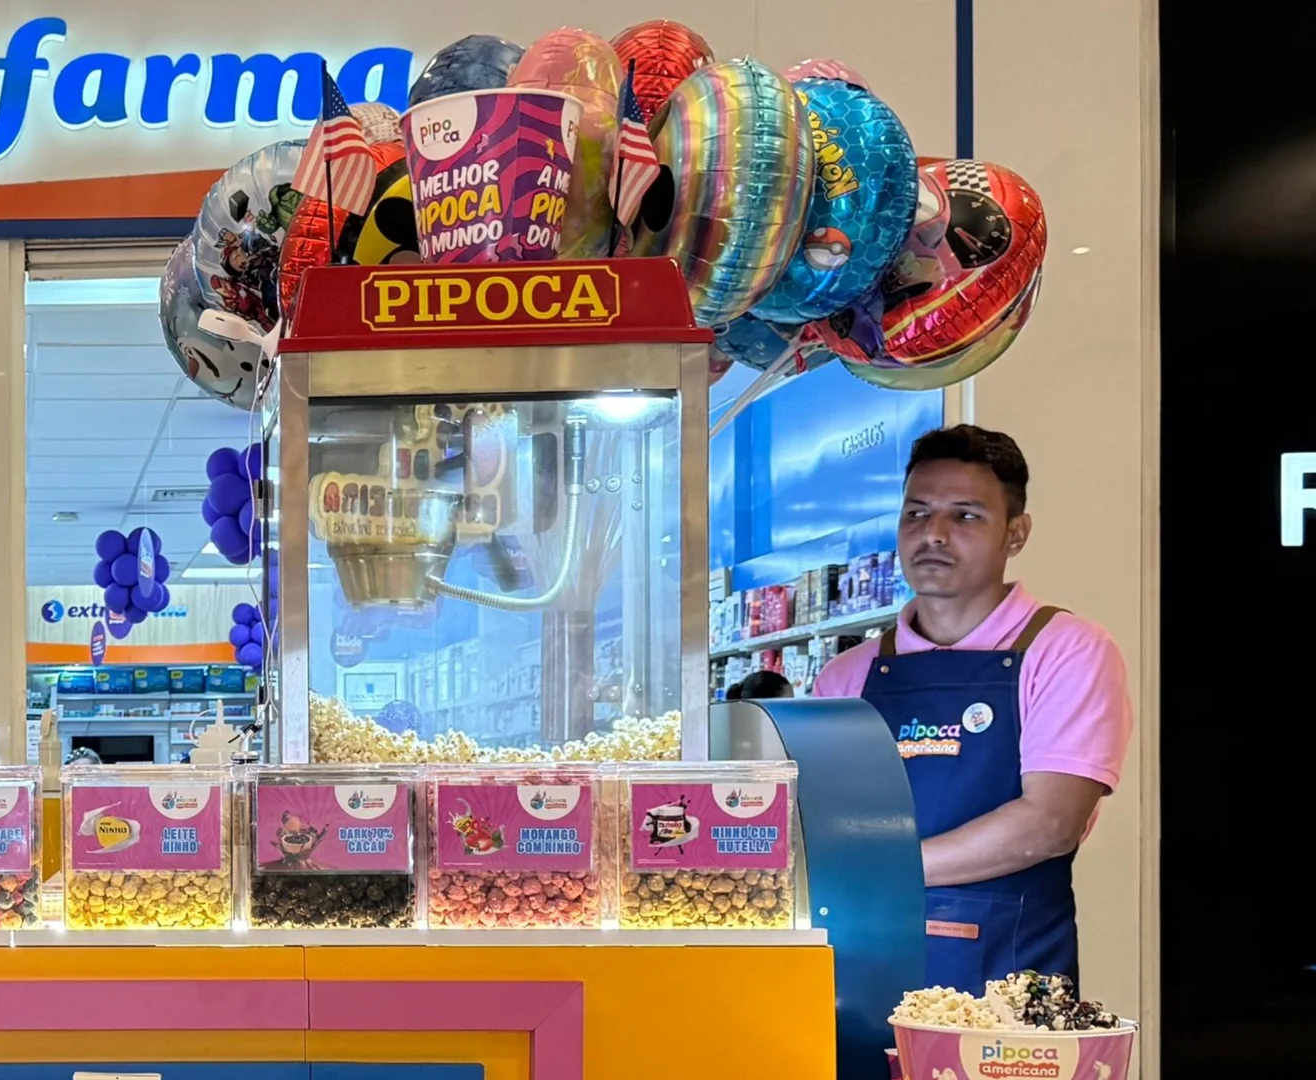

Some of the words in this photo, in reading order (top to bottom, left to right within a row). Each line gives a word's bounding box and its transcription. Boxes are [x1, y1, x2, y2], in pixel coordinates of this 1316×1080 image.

[420, 117, 452, 145] pipo
[443, 130, 460, 144] ca
[420, 159, 500, 201] MELHOR
[537, 165, 552, 188] A
[431, 220, 504, 256] MUNDO
[526, 224, 550, 249] DO
[372, 273, 609, 323] PIPOCA
[897, 718, 961, 741] pipoca
[99, 825, 128, 834] NINHO
[163, 827, 197, 840] LEITE
[339, 827, 369, 841] DARK
[370, 826, 395, 840] 70%
[520, 828, 577, 841] MORANGO
[711, 825, 748, 840] NINHO
[748, 825, 778, 840] COM
[162, 840, 199, 854] NINHO
[347, 840, 387, 853] CACAU
[516, 841, 543, 854] COM
[544, 840, 582, 855] NINHO
[716, 839, 773, 854] NUTELLA
[981, 1039, 1058, 1061] pipoca
[981, 1062, 1058, 1077] americana
